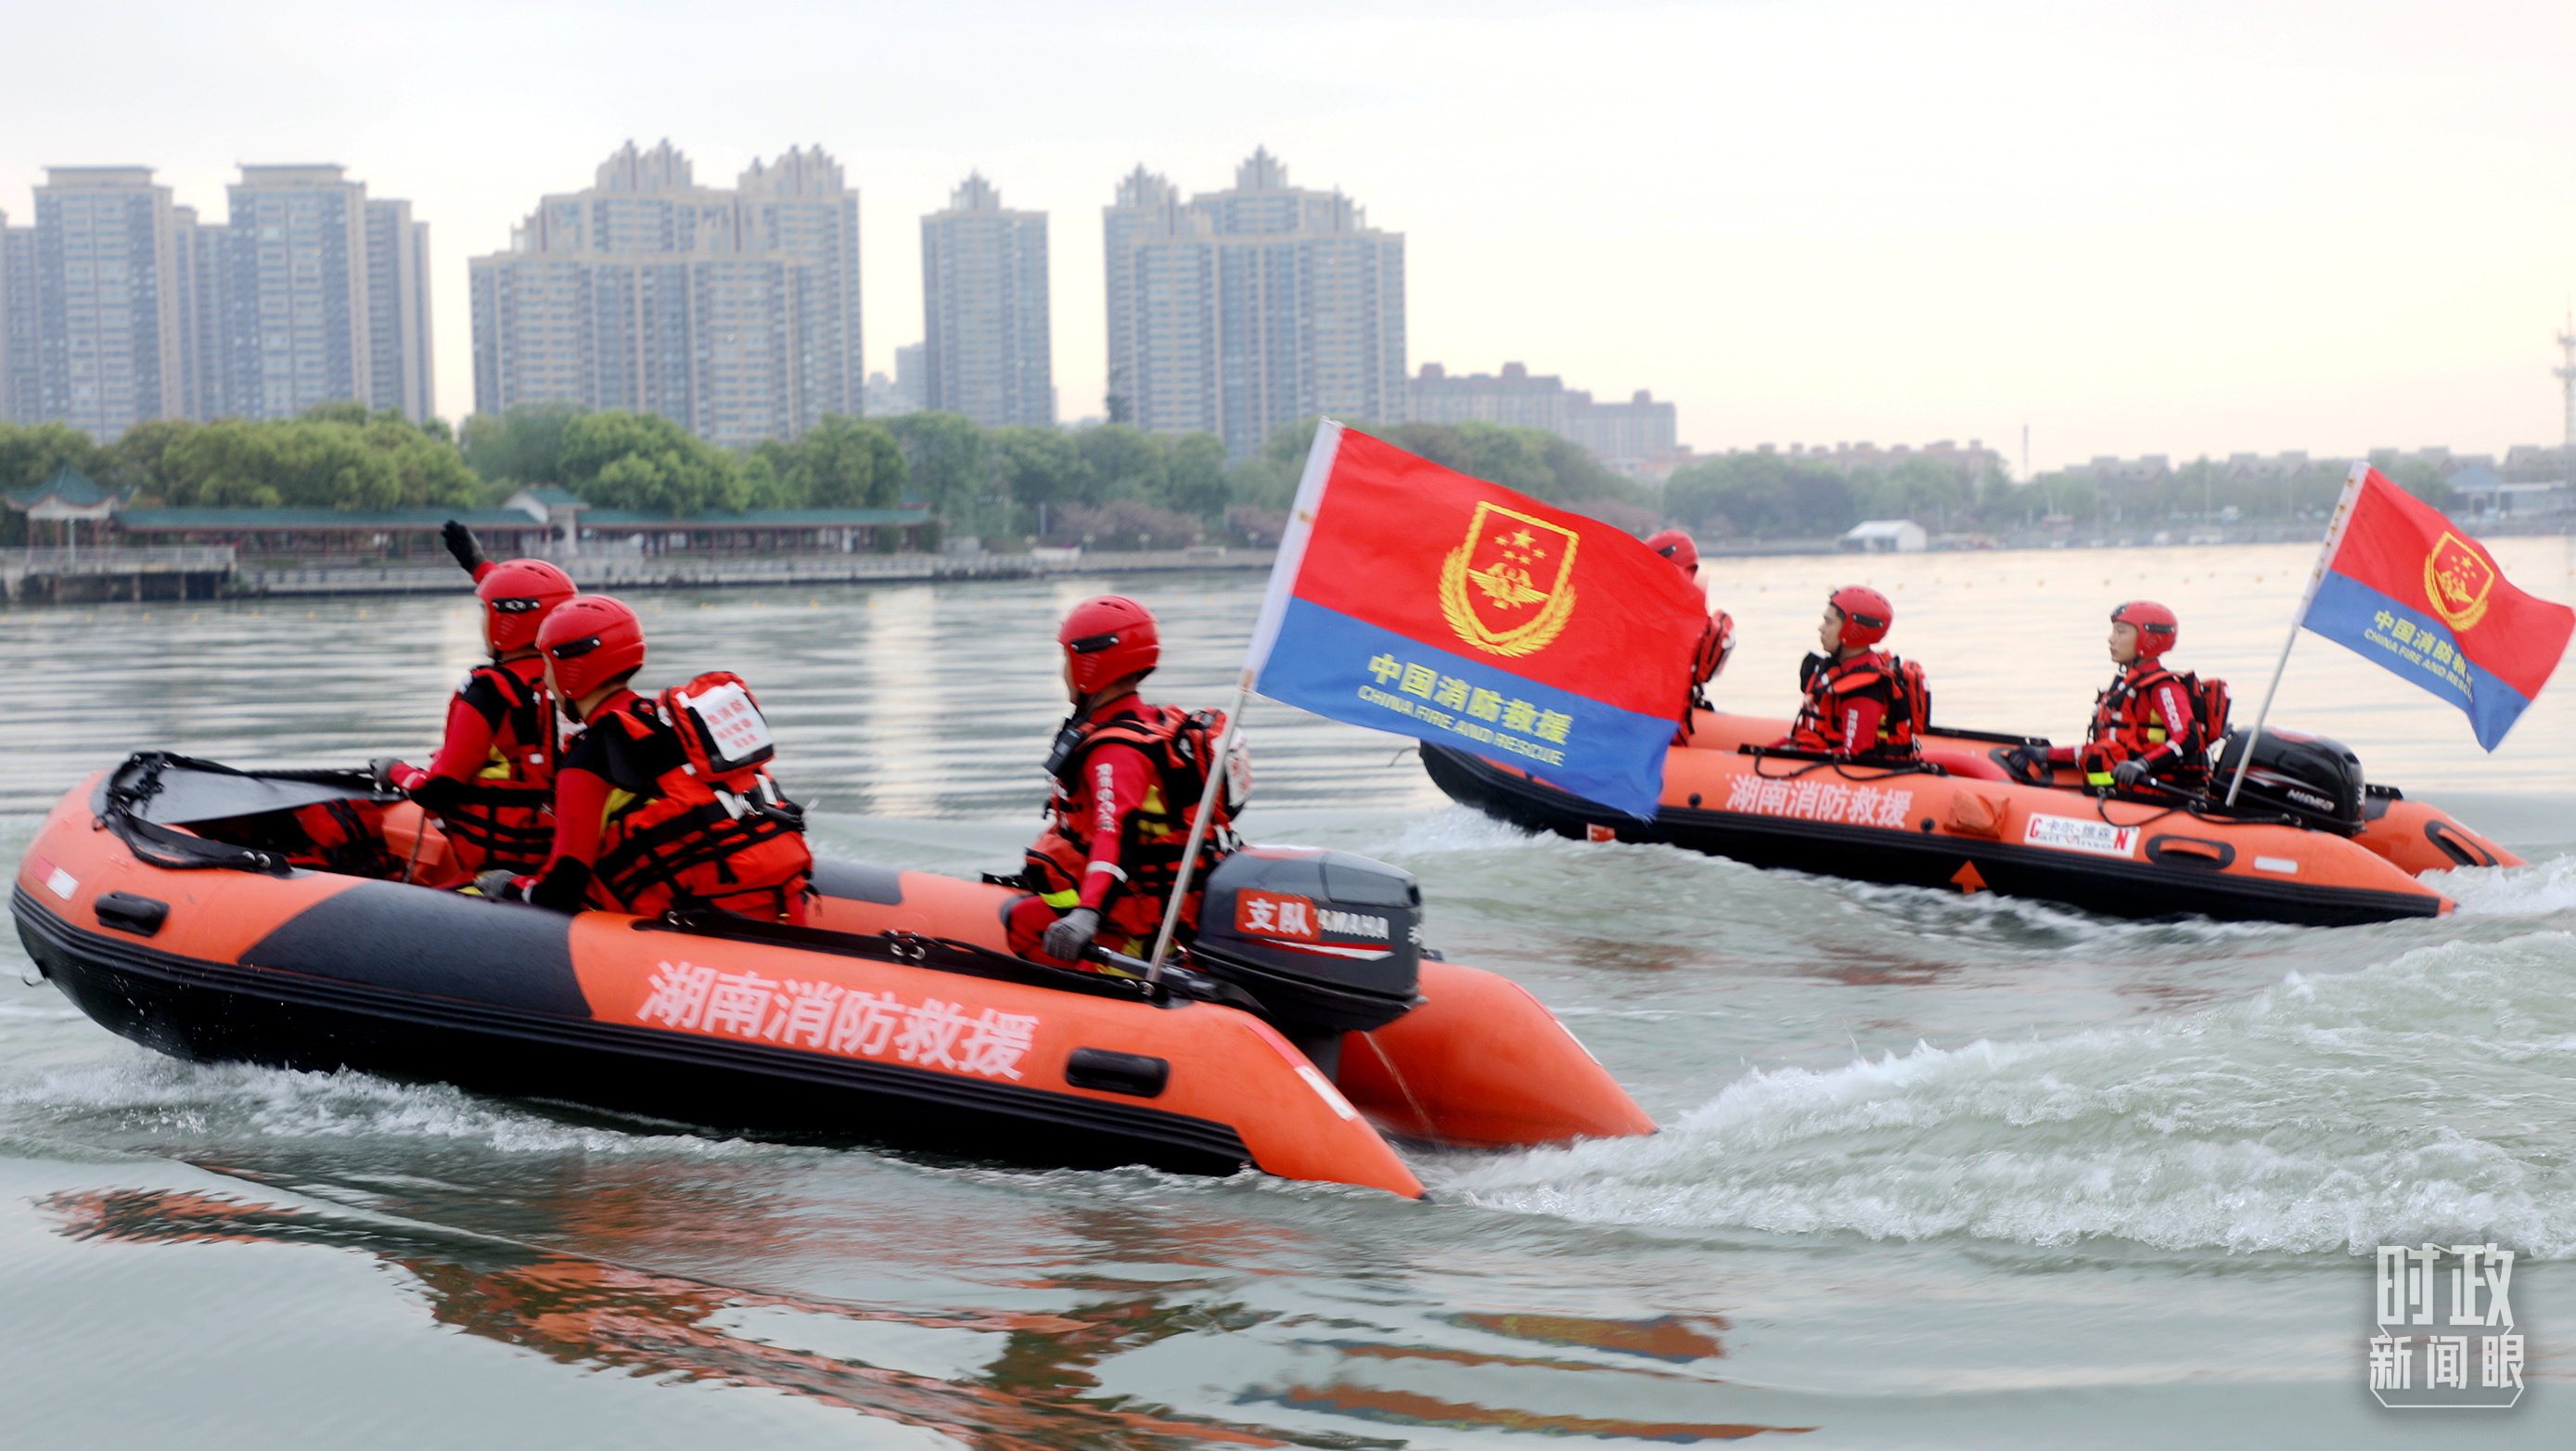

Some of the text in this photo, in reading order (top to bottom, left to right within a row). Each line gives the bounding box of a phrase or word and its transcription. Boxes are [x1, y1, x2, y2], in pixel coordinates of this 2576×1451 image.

[2365, 628, 2399, 653] CHINA
[2399, 646, 2421, 665] FIRE
[2422, 658, 2447, 678] AND
[1356, 684, 1565, 766] CHINA FIRE AND RESCUE
[1368, 652, 1573, 747] 中国消防救援
[2159, 687, 2184, 733] RESCU
[1725, 774, 1914, 829] 湖南消防救援
[1244, 897, 1313, 937] 支队
[1314, 907, 1390, 940] AMAHA
[635, 959, 1041, 1081] 湖南消防救援
